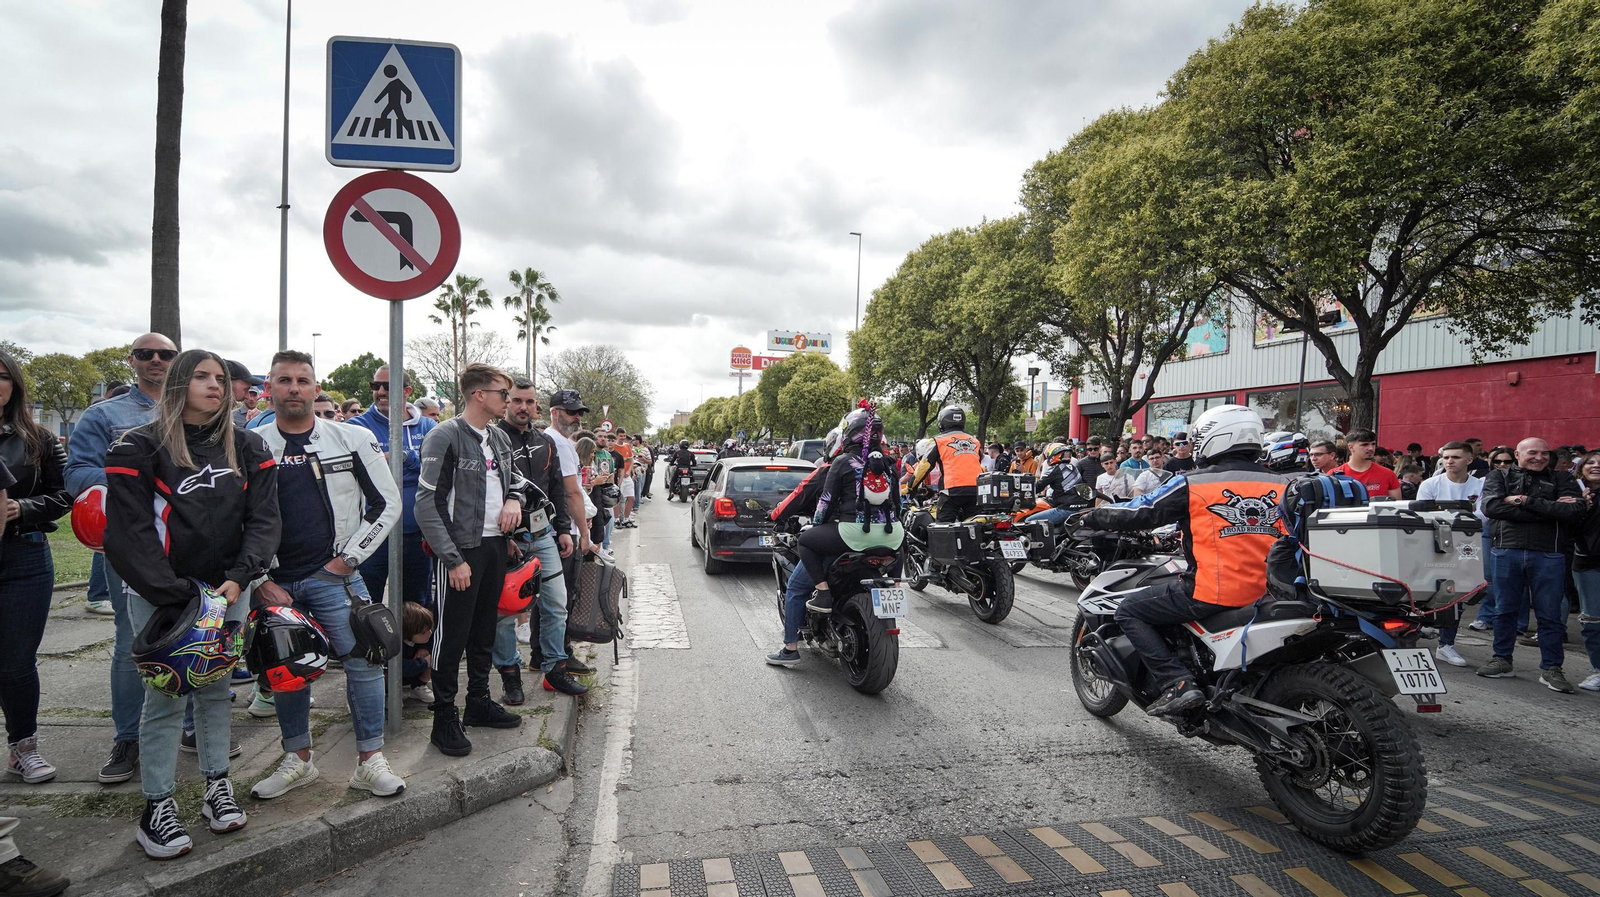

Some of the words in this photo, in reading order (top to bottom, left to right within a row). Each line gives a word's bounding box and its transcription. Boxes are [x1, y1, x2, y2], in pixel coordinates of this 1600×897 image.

[731, 357, 752, 365] KING
[880, 590, 904, 601] 5253
[882, 602, 901, 614] MNF
[1413, 654, 1430, 668] 75
[1400, 673, 1438, 688] 10770
